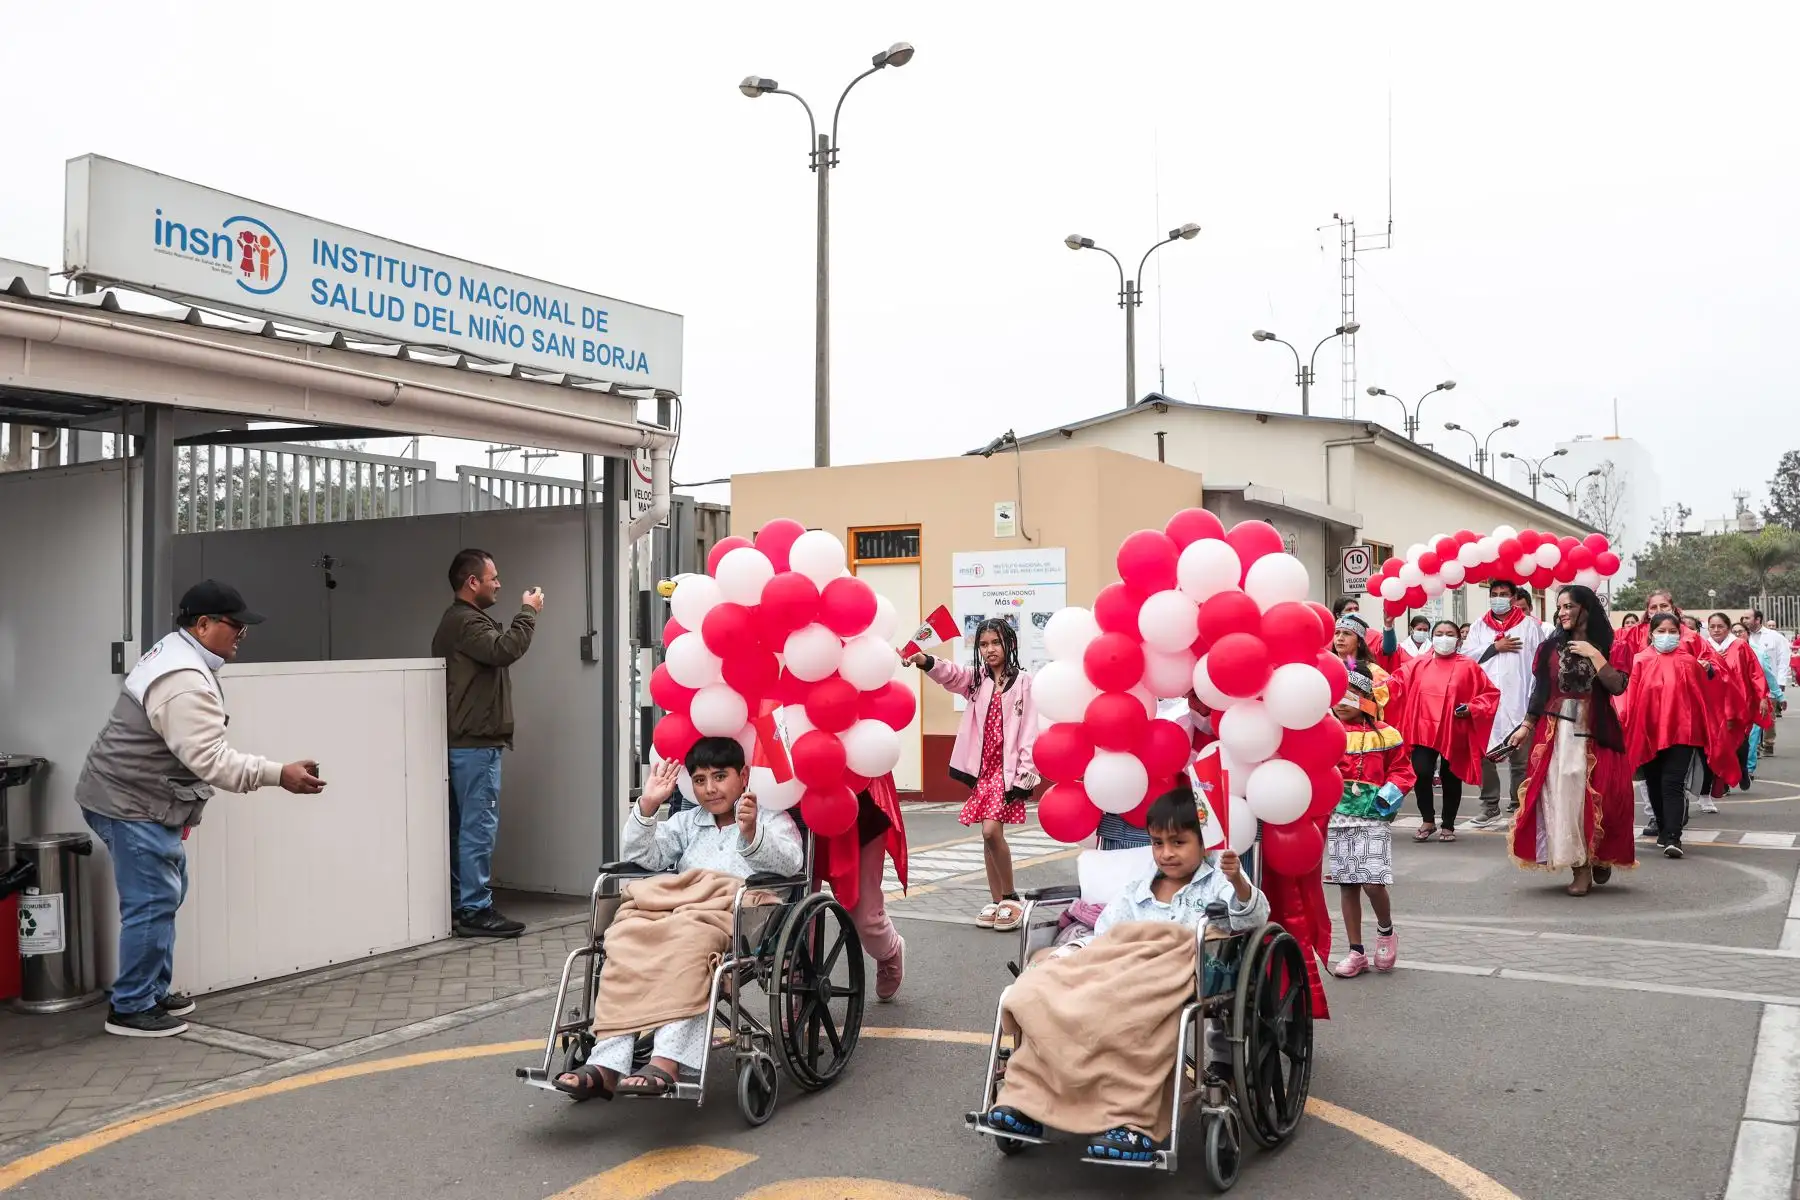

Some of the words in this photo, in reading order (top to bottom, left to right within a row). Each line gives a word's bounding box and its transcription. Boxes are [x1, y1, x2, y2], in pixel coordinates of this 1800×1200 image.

[155, 208, 233, 262] insn
[312, 238, 452, 297] INSTITUTO
[459, 276, 576, 326] NACIONAL
[582, 306, 609, 333] DE
[311, 277, 405, 322] SALUD
[414, 301, 462, 336] DEL
[468, 314, 525, 348] NIÑO
[531, 328, 575, 359] SAN
[582, 339, 650, 375] BORJA
[634, 488, 652, 501] VELOC
[1350, 554, 1363, 564] 10
